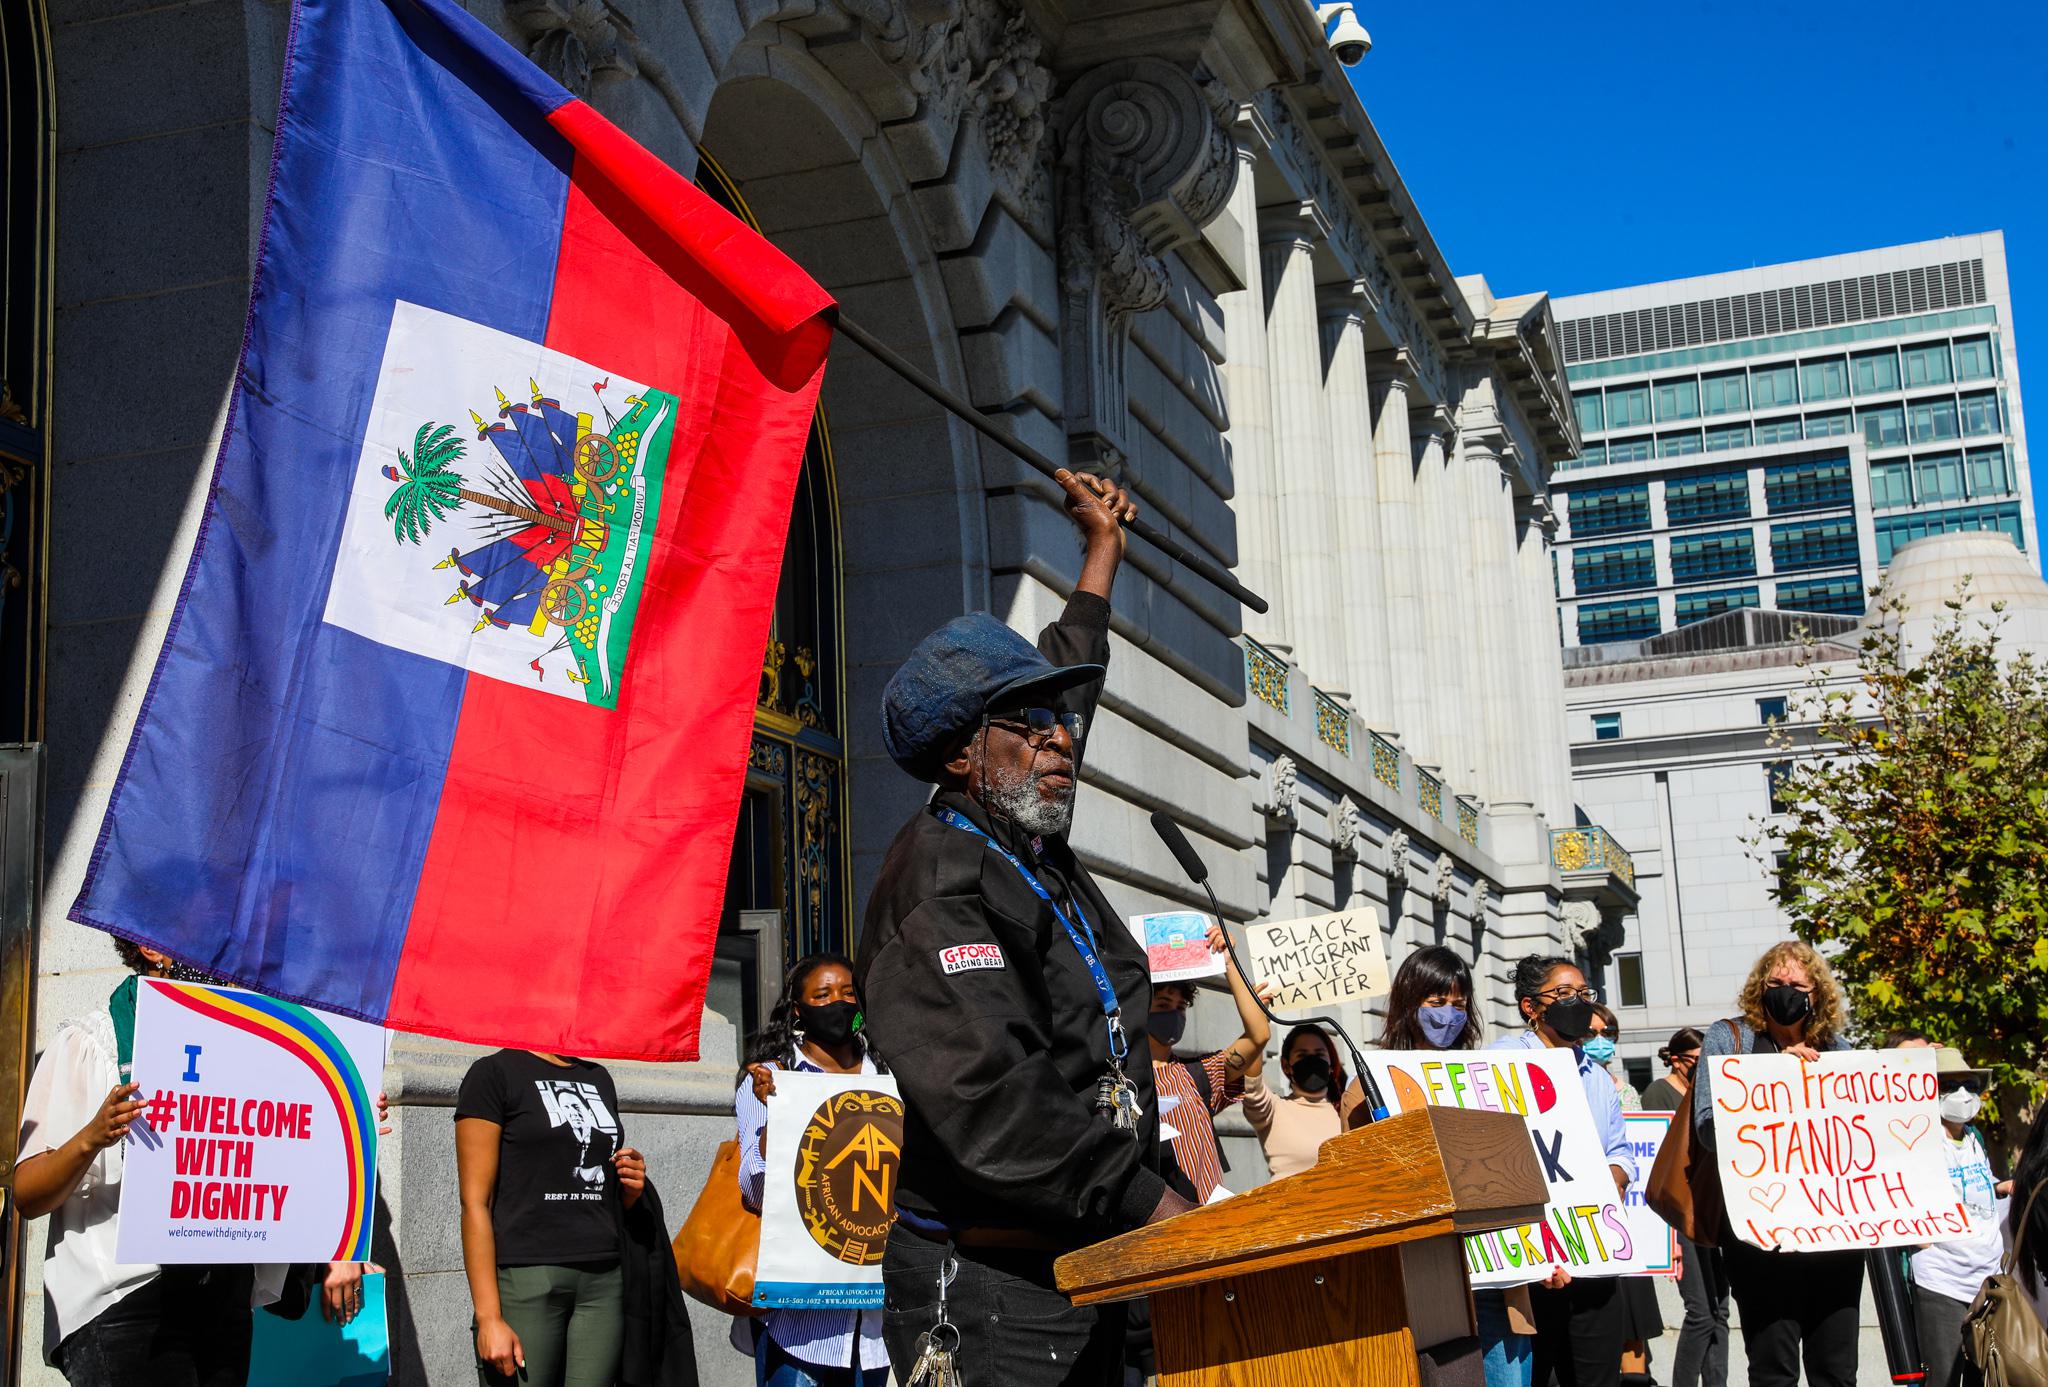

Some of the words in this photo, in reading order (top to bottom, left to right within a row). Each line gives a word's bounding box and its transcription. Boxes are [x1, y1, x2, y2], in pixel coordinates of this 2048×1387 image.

[1267, 917, 1357, 948] BLACK
[947, 958, 982, 972] RACING
[983, 958, 1003, 967] GEAR
[1257, 935, 1371, 977] IMMIGRANT
[1278, 958, 1357, 988] LIVES
[1270, 974, 1371, 1008] MATTER
[182, 1044, 202, 1082] I
[1387, 1062, 1557, 1116] DEFEND
[1717, 1058, 1792, 1113] San
[1800, 1057, 1938, 1109] Francisco
[146, 1089, 313, 1140] #WELCOME
[175, 1137, 254, 1178] WITH
[1731, 1114, 1876, 1178] STANDS
[169, 1181, 289, 1222] DIGNITY
[821, 1173, 842, 1220] AFRICAN
[839, 1218, 890, 1237] ADVOCACY
[1799, 1172, 1915, 1216] WITH
[168, 1225, 268, 1241] welcomewithdignity.org
[1464, 1203, 1633, 1274] MIGRANTS
[1746, 1203, 1972, 1248] Immigrants!
[817, 1288, 844, 1296] AFRICAN
[845, 1288, 873, 1296] ADVOCACY
